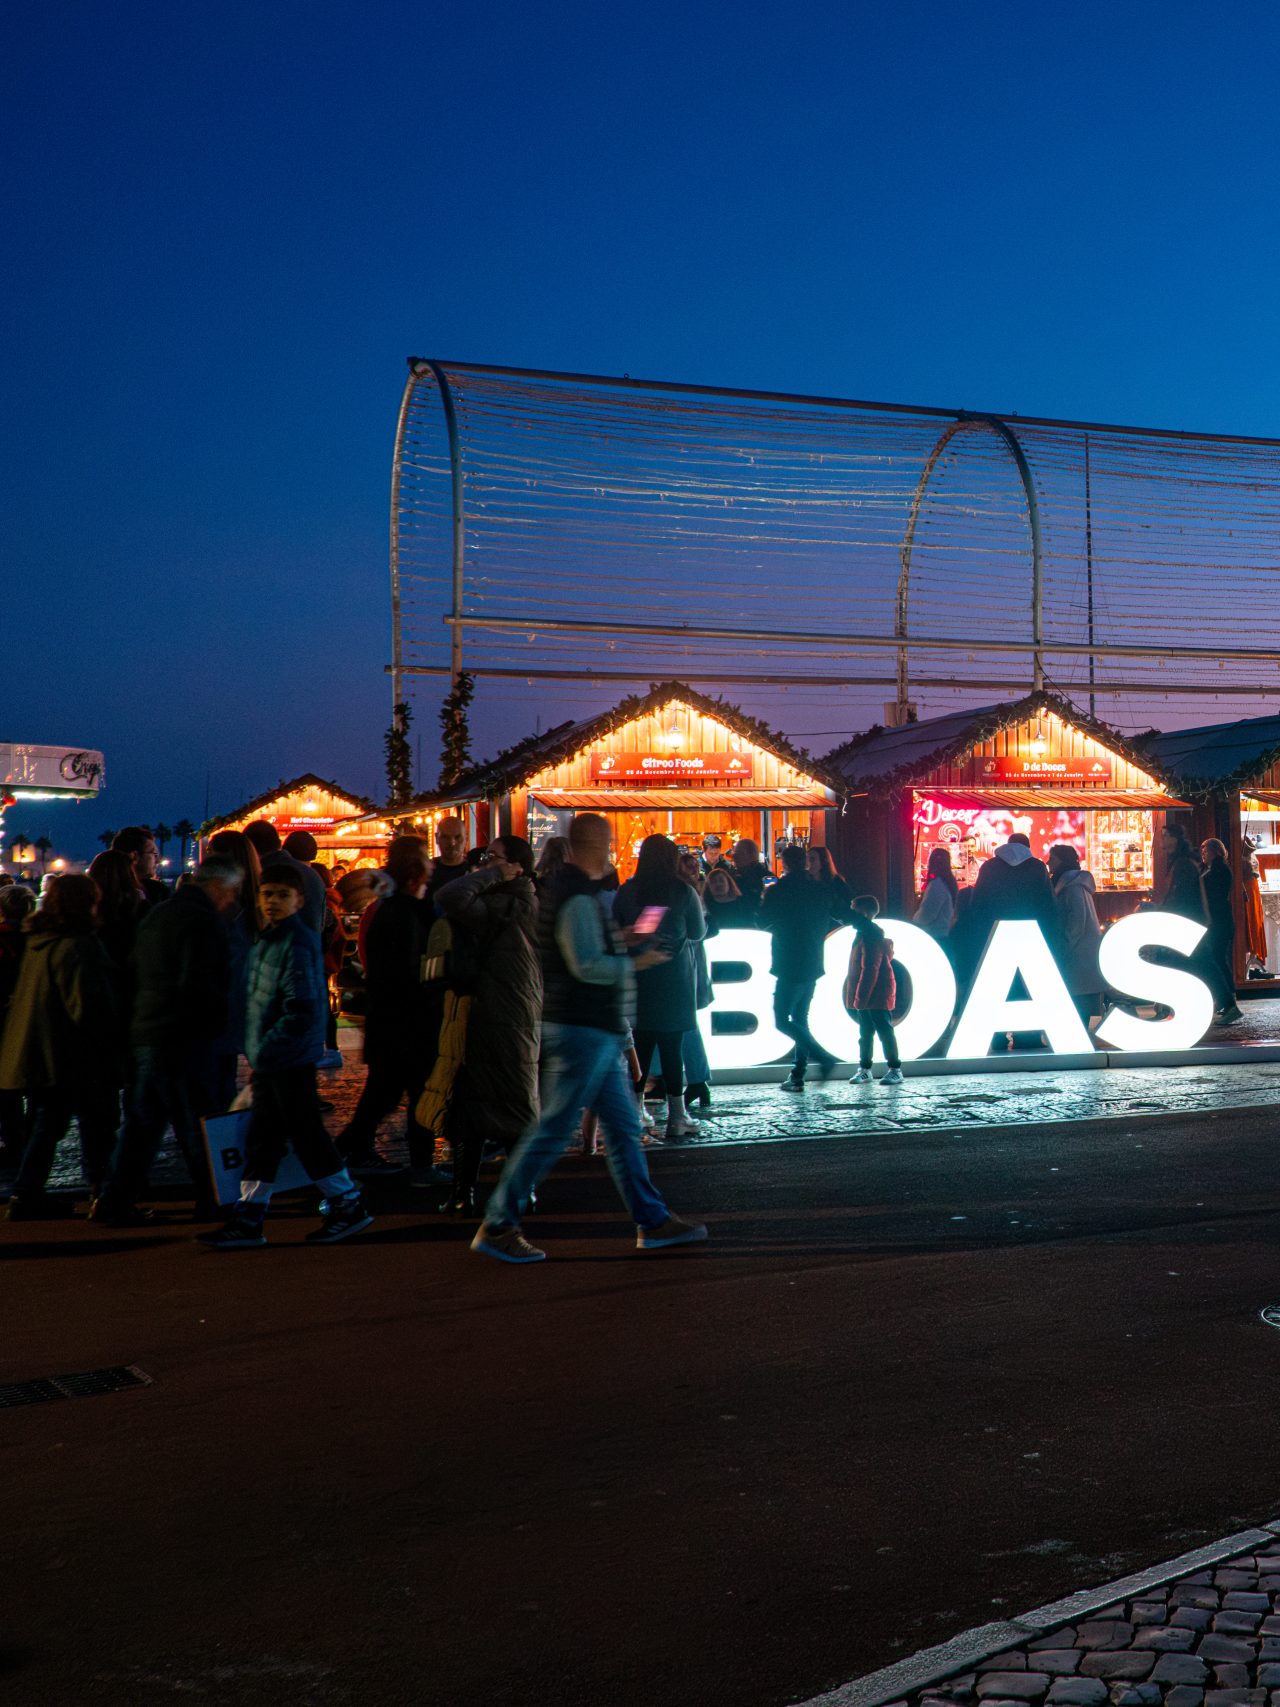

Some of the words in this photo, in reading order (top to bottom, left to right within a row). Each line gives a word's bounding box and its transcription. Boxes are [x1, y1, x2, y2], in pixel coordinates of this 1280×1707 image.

[641, 757, 674, 769] Citroo
[675, 757, 704, 769] Foods
[1023, 762, 1031, 772] D
[1031, 762, 1041, 772] de
[1041, 762, 1067, 772] Doces
[920, 799, 981, 826] Doces
[696, 911, 1214, 1068] BOAS
